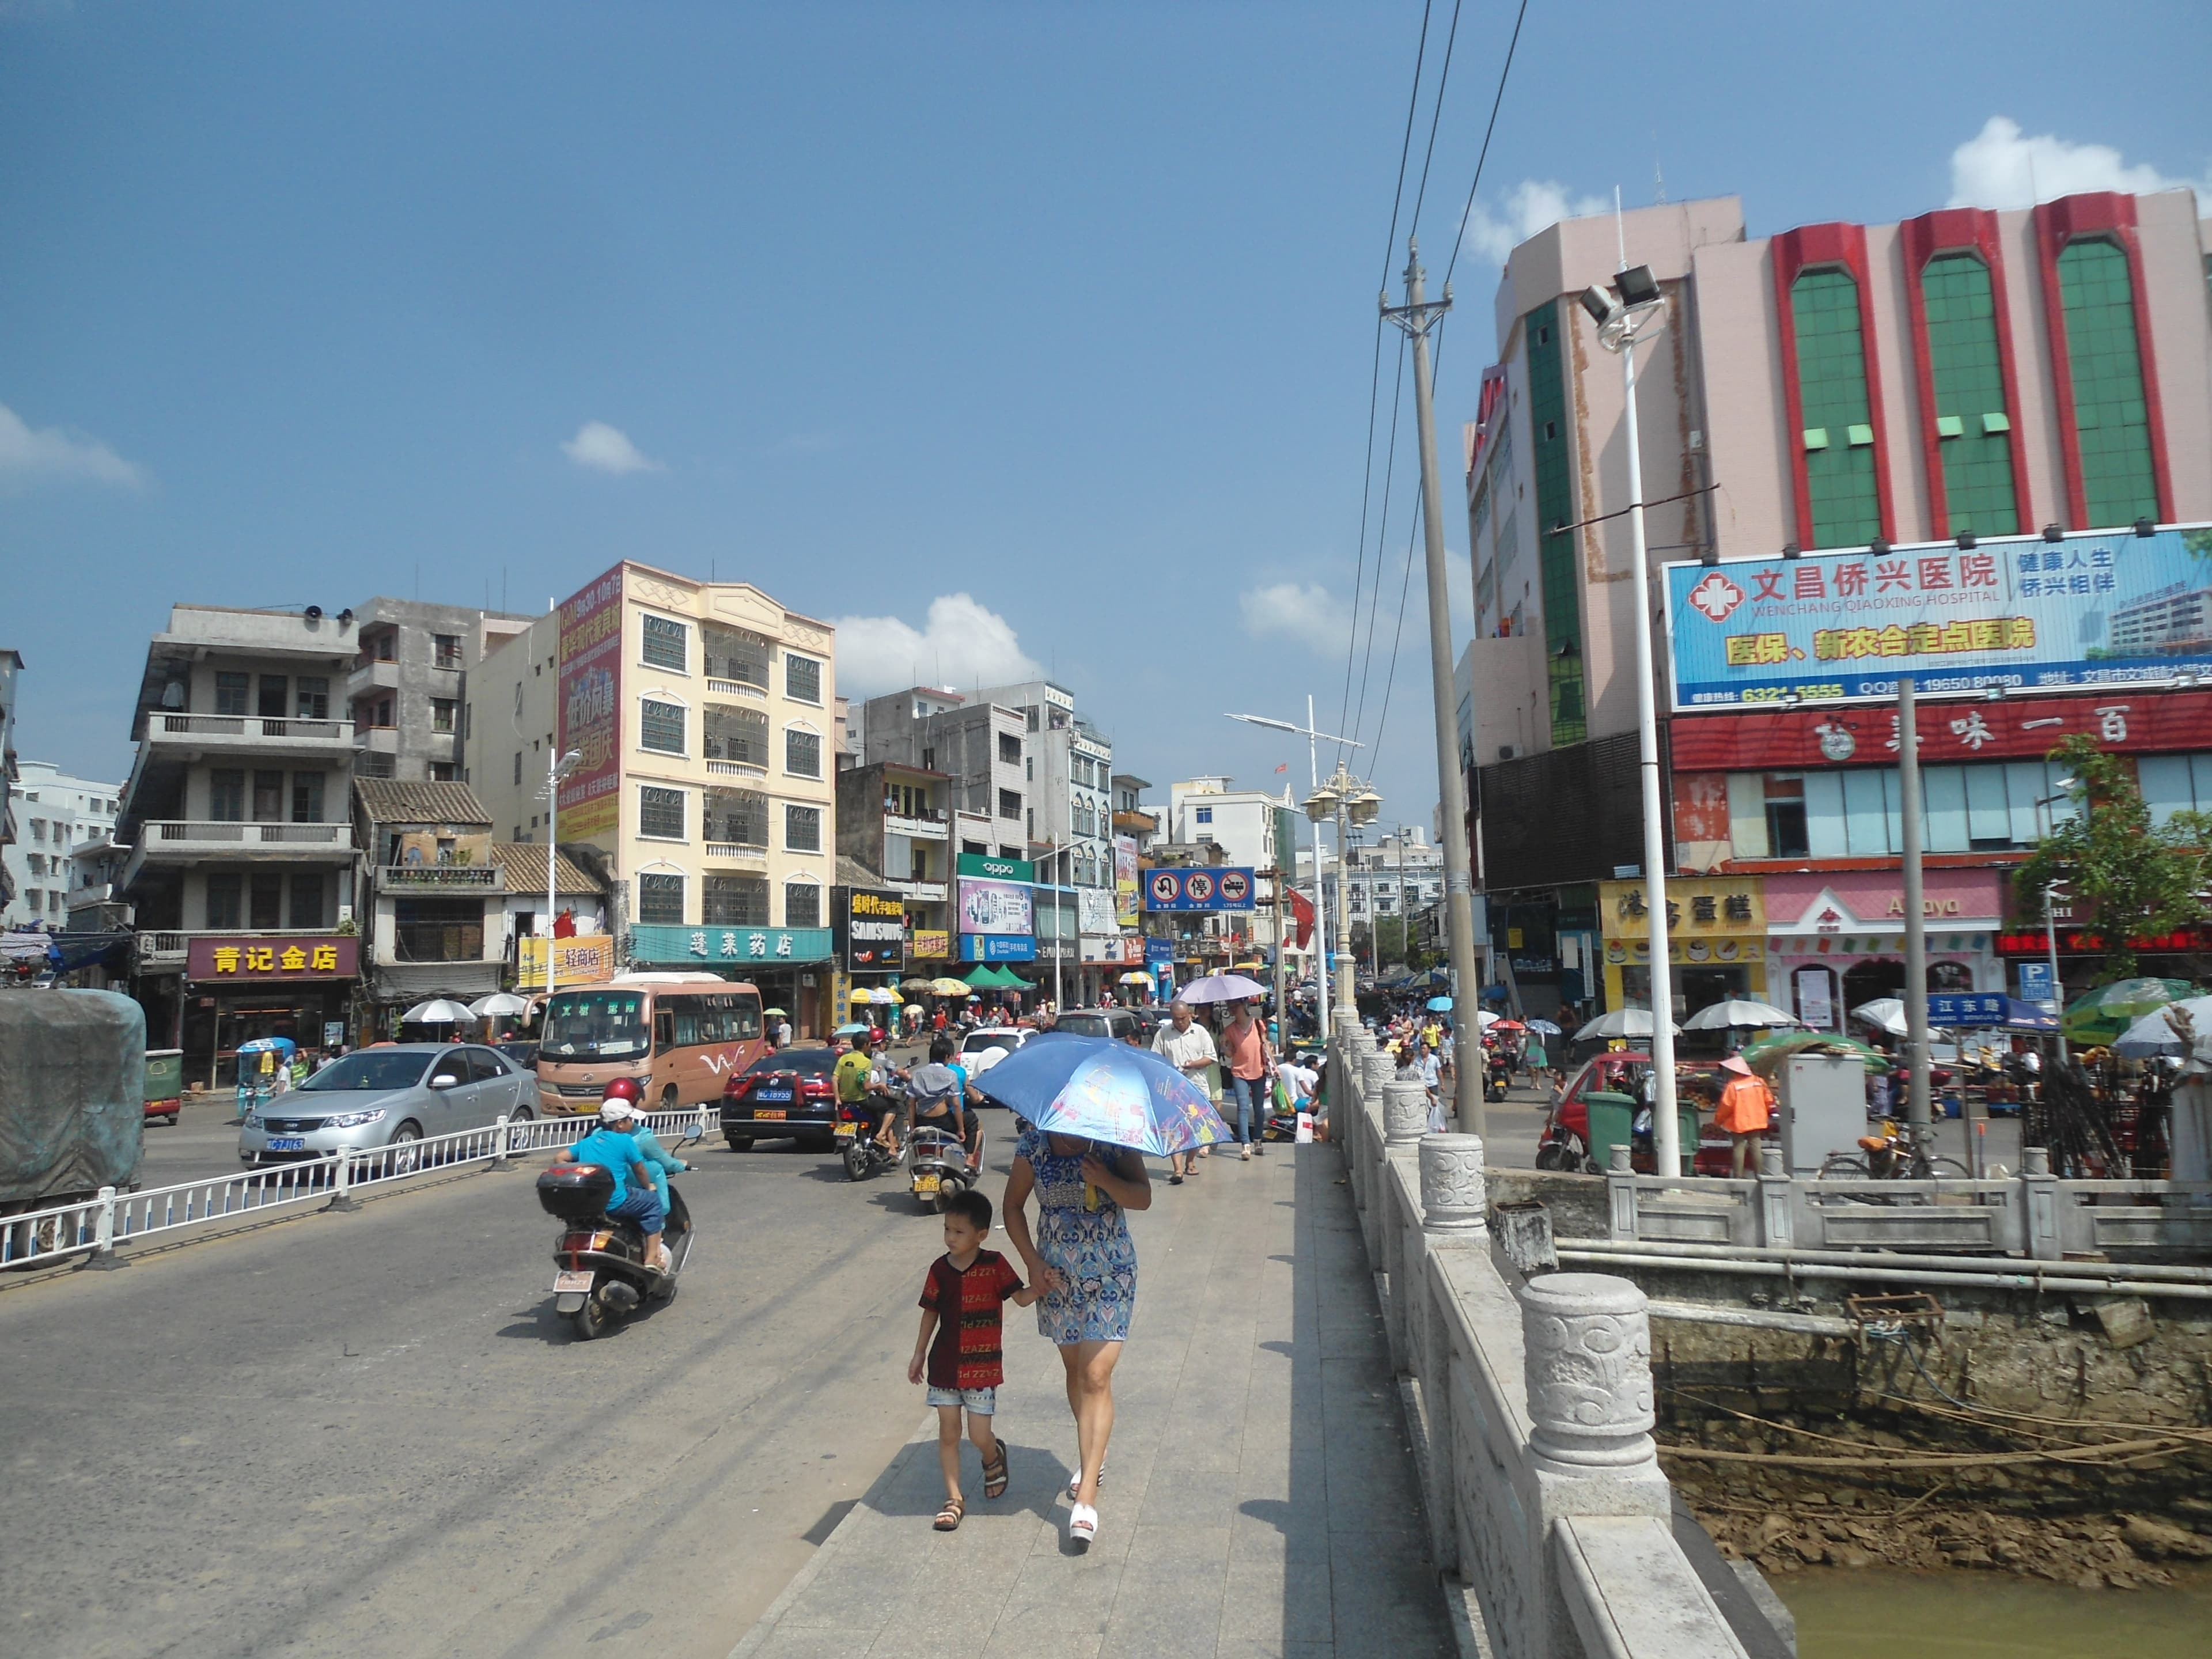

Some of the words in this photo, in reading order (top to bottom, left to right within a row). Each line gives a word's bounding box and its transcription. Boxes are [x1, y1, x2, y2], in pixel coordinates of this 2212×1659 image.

[2018, 548, 2113, 573] 健康人生
[1751, 552, 1998, 602] 文昌侨兴医院
[2019, 572, 2116, 599] 侨兴相伴
[1752, 601, 1842, 617] WENCHANG
[1846, 595, 1922, 613] QIAOXING
[1927, 591, 2000, 606] HOSPITAL
[1923, 677, 1971, 691] 19650
[690, 931, 794, 957] 蓬莱药店
[851, 921, 903, 941] SAMSUNG
[213, 944, 338, 973] 青记金店
[1926, 998, 1999, 1013] 江东路
